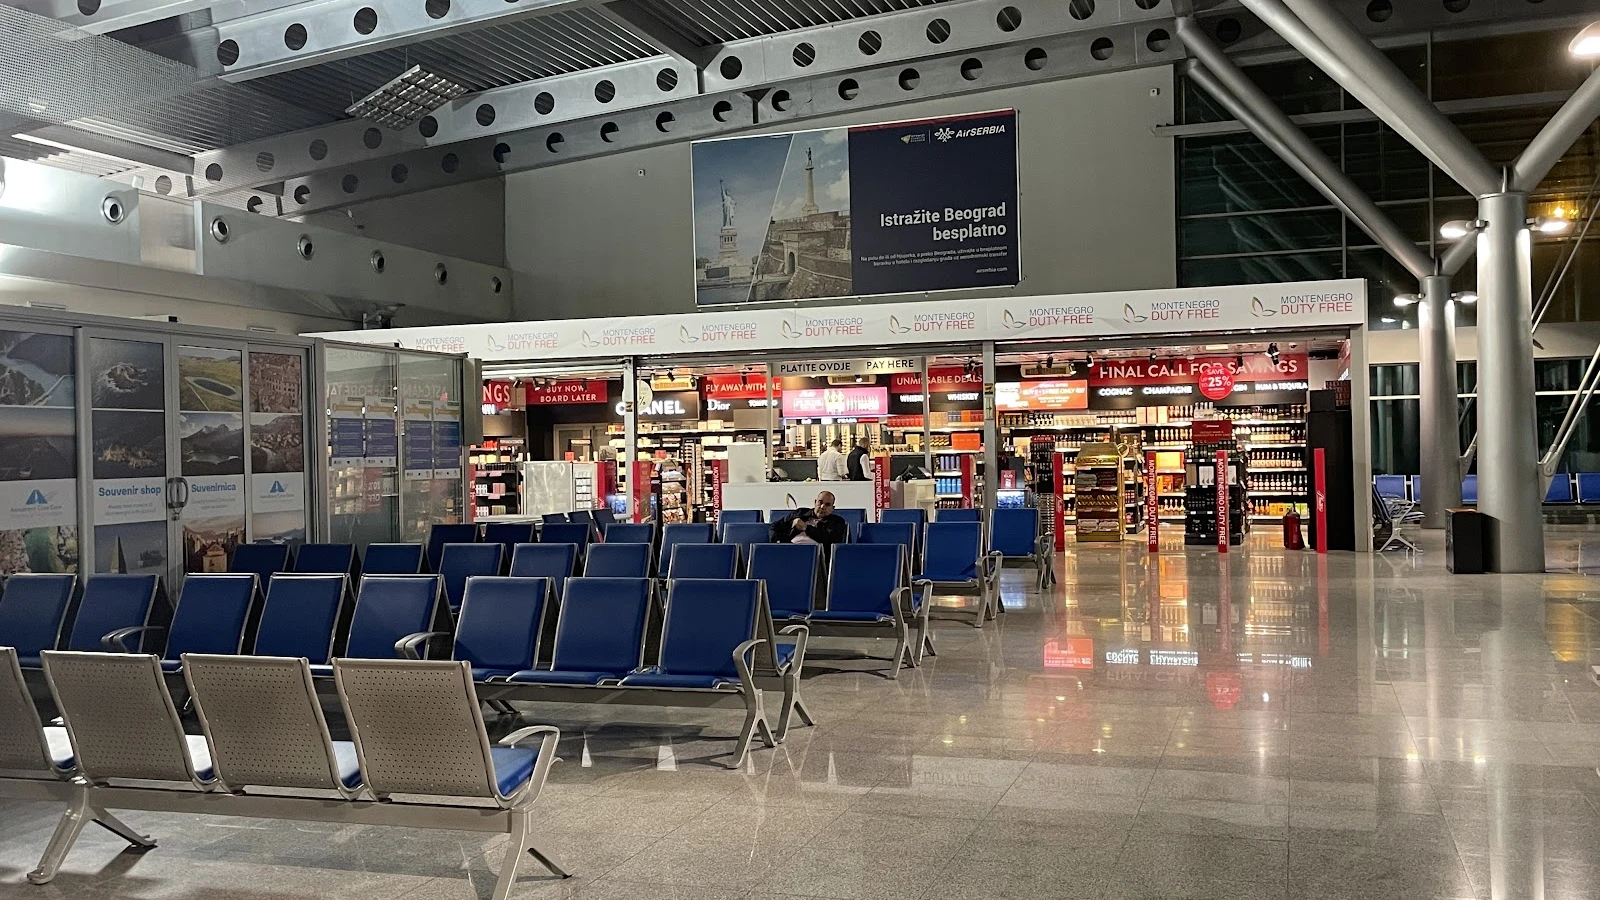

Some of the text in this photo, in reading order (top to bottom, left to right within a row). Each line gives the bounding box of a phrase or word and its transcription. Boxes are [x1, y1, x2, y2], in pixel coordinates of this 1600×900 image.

[955, 124, 1006, 139] AirSERBIA
[880, 202, 1006, 227] Istražite Beograd
[933, 223, 1007, 242] besplatno
[1280, 293, 1353, 304] MONTENEGRO
[1029, 306, 1094, 316] MONTENEGRO
[1151, 300, 1220, 311] MONTENEGRO
[1281, 301, 1352, 315] DUTY FREE
[914, 312, 975, 322] MONTENEGRO
[1030, 314, 1093, 326] DUTY FREE
[1152, 308, 1219, 321] DUTY FREE
[702, 322, 757, 332] MONTENEGRO
[805, 317, 863, 327] MONTENEGRO
[914, 320, 975, 332] DUTY FREE
[602, 328, 655, 336] MONTENEGRO
[805, 324, 862, 336] DUTY FREE
[416, 337, 464, 345] MONTENEGRO
[508, 332, 558, 341] MONTENEGRO
[603, 335, 655, 346] DUTY FREE
[702, 330, 756, 342] DUTY FREE
[508, 339, 558, 350] DUTY FREE
[780, 362, 850, 373] PLATITE OVDJE
[866, 360, 914, 370] PAY HERE
[1100, 365, 1145, 379] FINAL
[1147, 364, 1186, 377] CALL
[1227, 360, 1298, 375] SAVINGS
[897, 374, 982, 385] UNMISABLE DEALS
[1208, 376, 1232, 387] 25%
[546, 385, 562, 394] BUY
[706, 384, 719, 392] FLY
[721, 383, 744, 391] AWAY
[745, 382, 766, 391] WITH
[1099, 385, 1193, 396] COGNAC CHAMPAGNE
[1278, 382, 1308, 390] TEQUILA
[483, 384, 510, 402] NGS
[540, 394, 597, 402] BOARD LATER
[947, 392, 979, 400] WHISKEY
[615, 400, 686, 416] CANEL
[707, 399, 730, 410] Dior
[191, 482, 236, 493] Suvenirnica
[1148, 460, 1156, 506] MONTENEGRO
[98, 485, 162, 496] Souvenir shop
